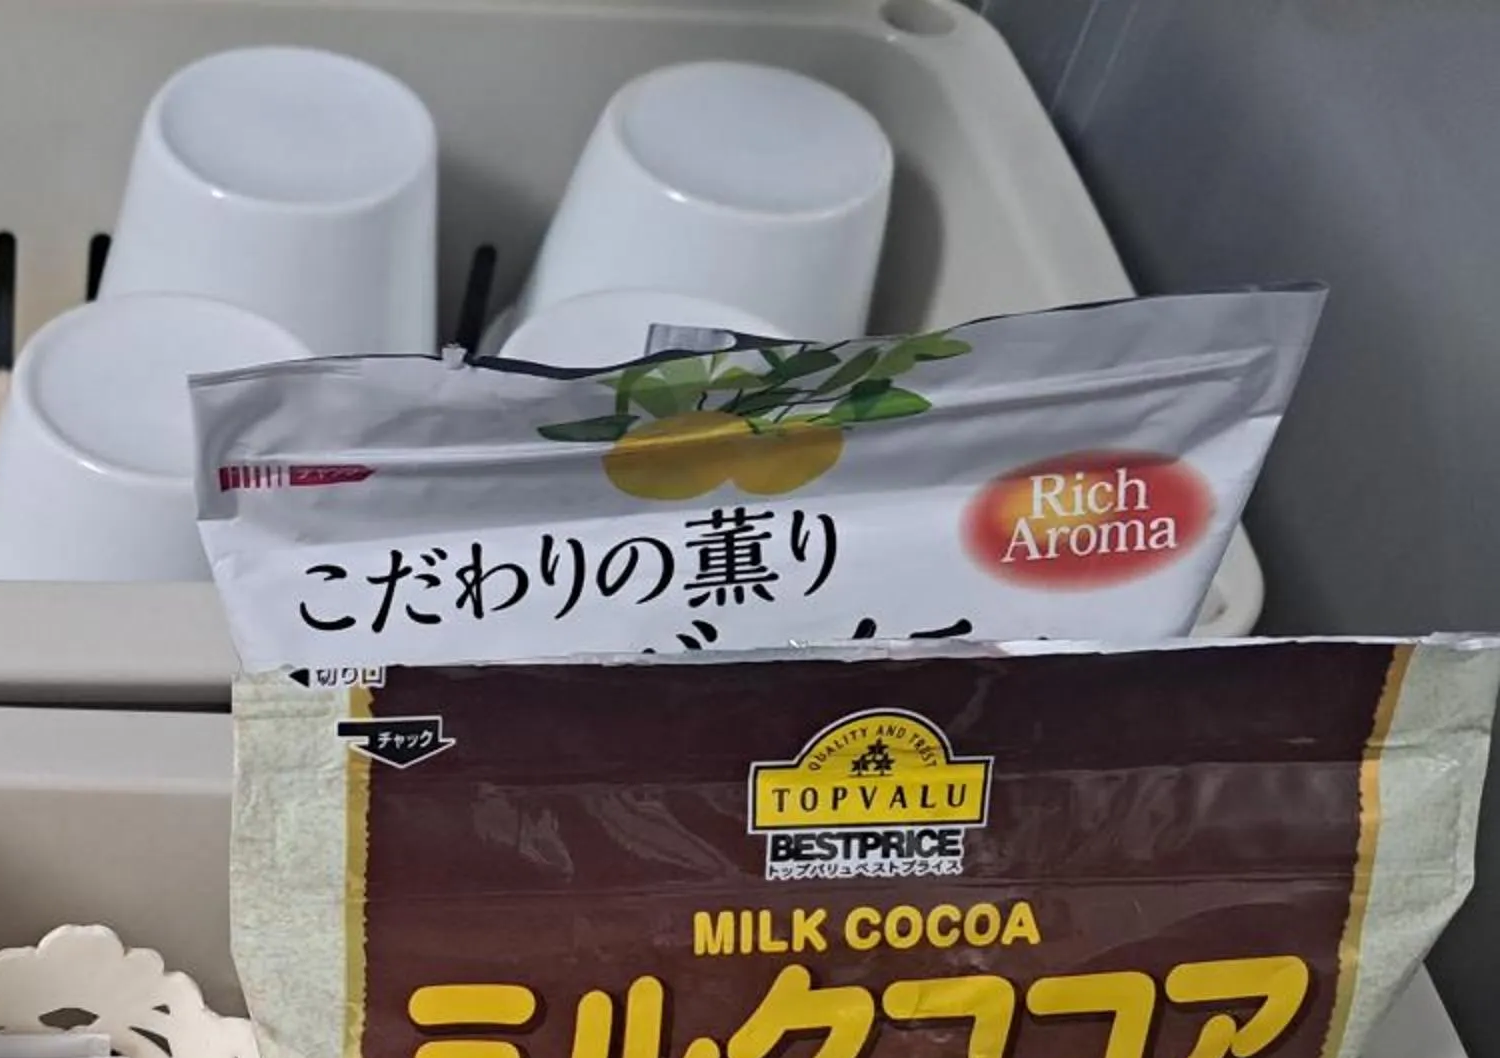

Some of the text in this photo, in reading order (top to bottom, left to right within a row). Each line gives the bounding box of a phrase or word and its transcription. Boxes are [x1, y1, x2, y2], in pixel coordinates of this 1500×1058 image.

[1029, 467, 1149, 520] Rich
[1000, 515, 1179, 563] Aroma
[299, 506, 838, 634] こだわりの薫り
[376, 729, 434, 749] チャック
[807, 724, 938, 772] QUALITY AND TRUST
[770, 783, 968, 813] TOPVALU
[770, 829, 961, 862] BESTPRICE
[692, 902, 1041, 956] MILK COCOA
